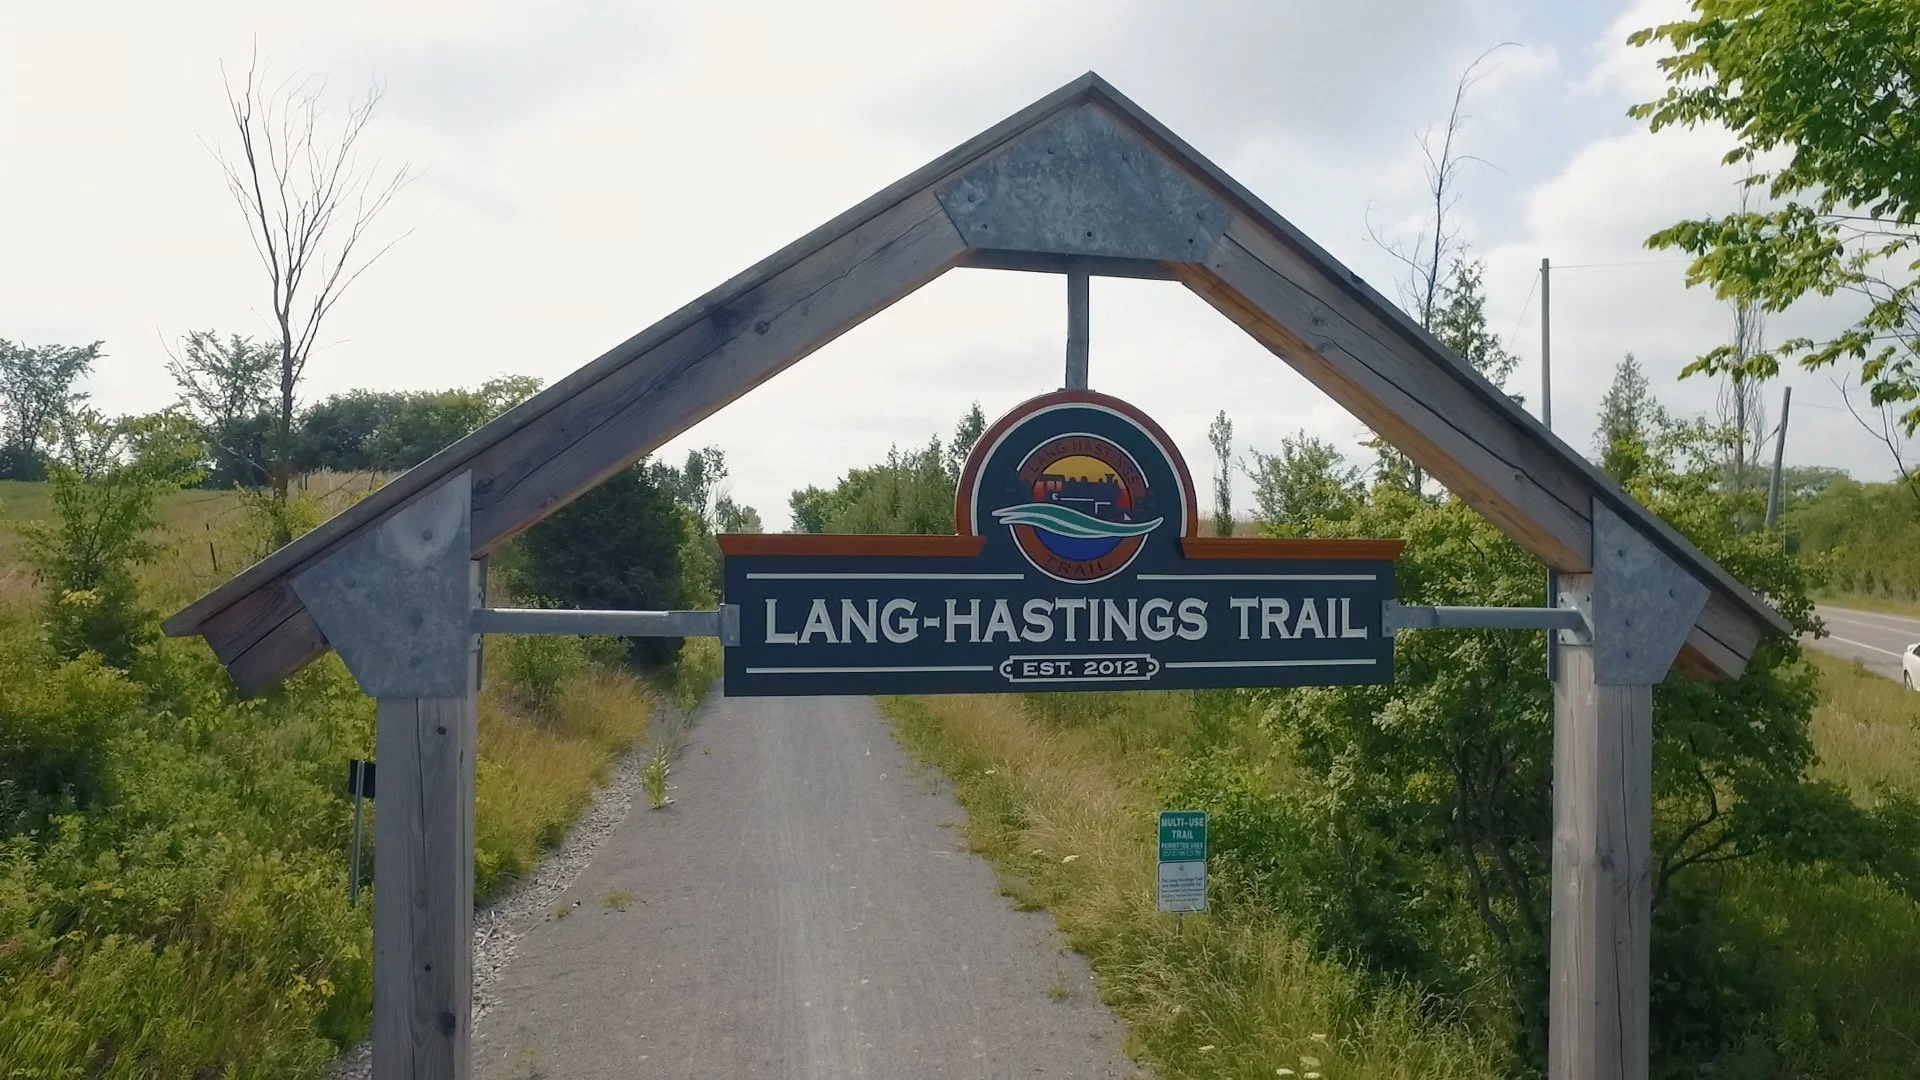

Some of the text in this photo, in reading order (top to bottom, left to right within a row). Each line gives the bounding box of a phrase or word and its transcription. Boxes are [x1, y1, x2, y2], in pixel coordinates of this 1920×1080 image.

[1047, 554, 1110, 576] TRAIL
[764, 596, 1368, 645] LANG-HASTINGS TRAIL
[1022, 661, 1140, 676] EST. 2012
[1161, 817, 1204, 827] MULTI-USE
[1171, 829, 1194, 839] TRAIL
